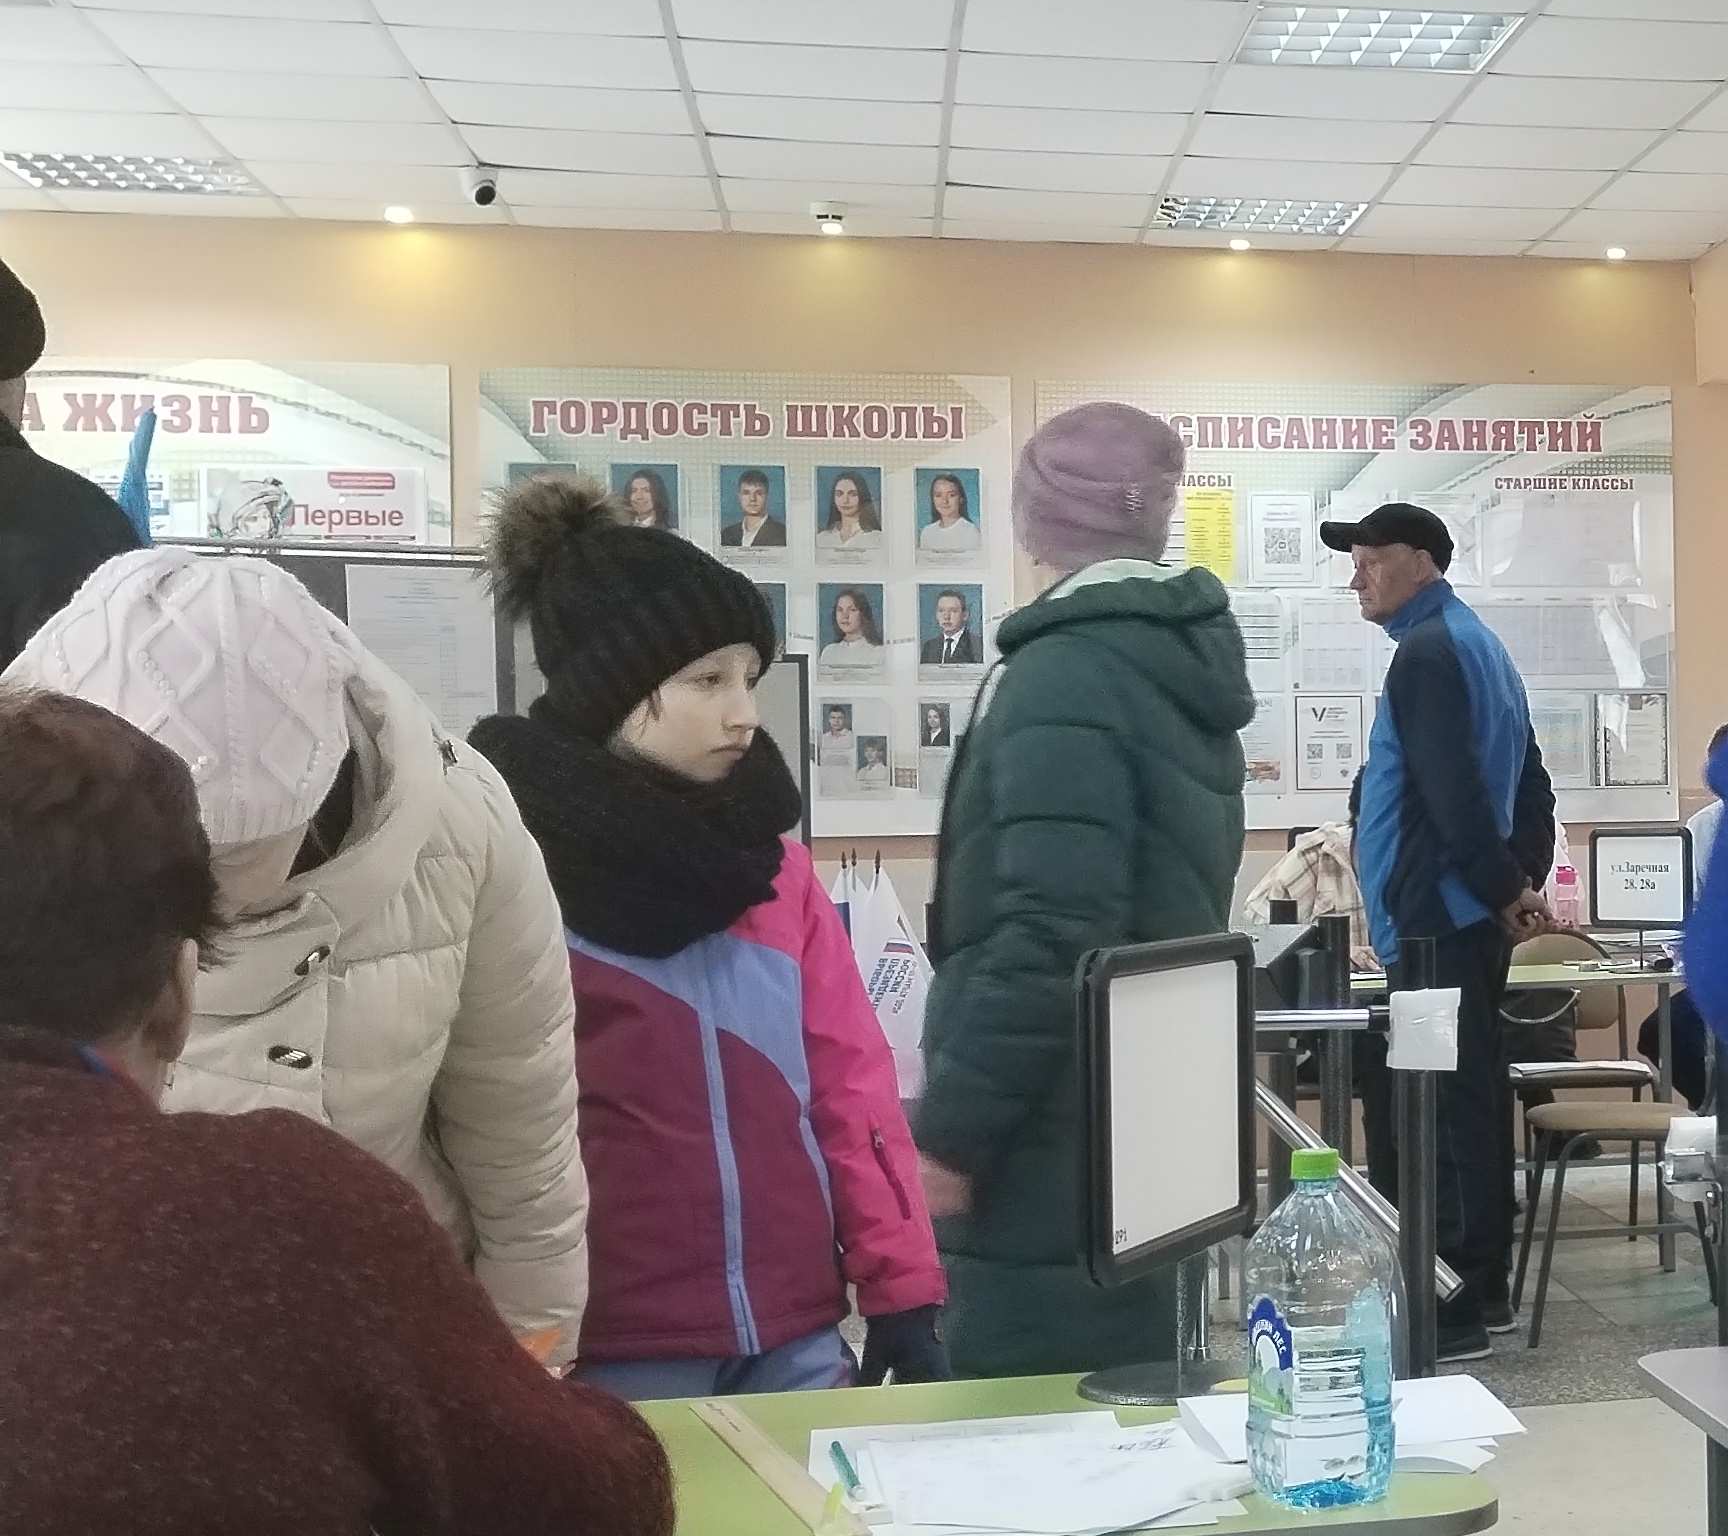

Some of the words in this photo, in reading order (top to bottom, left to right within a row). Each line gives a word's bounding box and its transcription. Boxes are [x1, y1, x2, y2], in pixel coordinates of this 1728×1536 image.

[63, 393, 269, 434] ЖИЗНЬ
[531, 400, 771, 441] ГОРДОСТЬ
[785, 404, 966, 439] ШКОЛЫ
[1168, 415, 1396, 451] СПИСАНИЕ
[1408, 413, 1603, 453] ЗАНЯТИЙ
[1178, 474, 1233, 488] ЛАССЫ
[1494, 477, 1568, 491] СТАРШИЕ
[1571, 478, 1635, 491] КЛАССЫ
[291, 503, 404, 533] Первые
[1610, 861, 1670, 875] ул.Заречная
